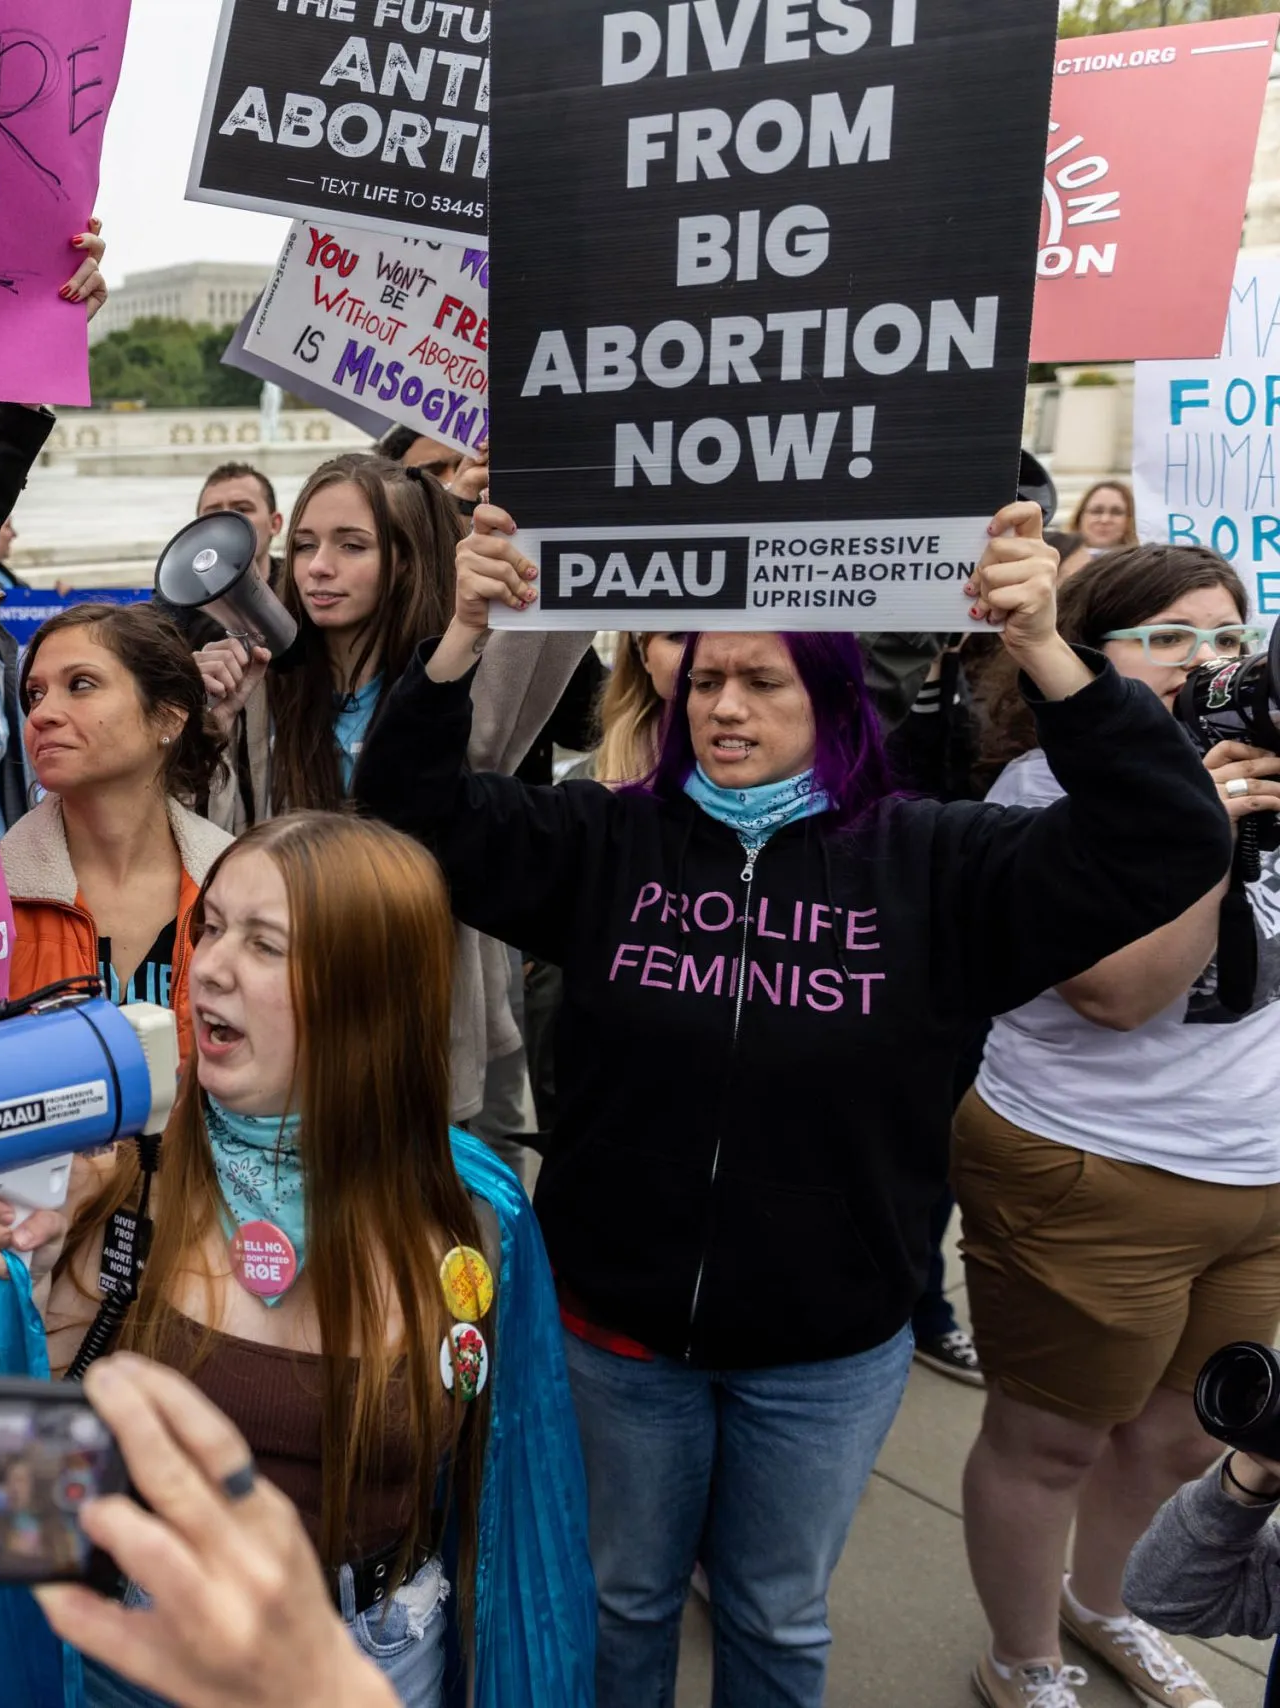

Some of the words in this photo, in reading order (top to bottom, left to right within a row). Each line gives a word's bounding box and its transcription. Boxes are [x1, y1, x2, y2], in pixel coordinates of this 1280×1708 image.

[1054, 47, 1177, 76] CTION.ORG
[219, 86, 489, 179] ABORTI
[627, 85, 895, 189] FROM
[320, 177, 360, 197] TEXT
[363, 184, 398, 204] LIFE
[404, 191, 426, 208] TO
[430, 196, 484, 219] 53445
[306, 227, 359, 278] YOU
[376, 252, 436, 298] WON'T
[677, 204, 830, 287] BIG
[380, 285, 409, 310] BE
[293, 325, 325, 363] IS
[314, 275, 407, 345] WITHOUT
[409, 335, 488, 395] ABORTIO
[520, 296, 999, 397] ABORTION
[614, 405, 876, 487] NOW!
[558, 550, 727, 598] PAAU
[753, 561, 975, 583] ANTI-ABORTION
[755, 535, 941, 558] PROGRESSIVE
[752, 589, 878, 608] UPRISING
[630, 881, 881, 951] PRO-LIFE
[609, 943, 885, 1015] FEMINIST
